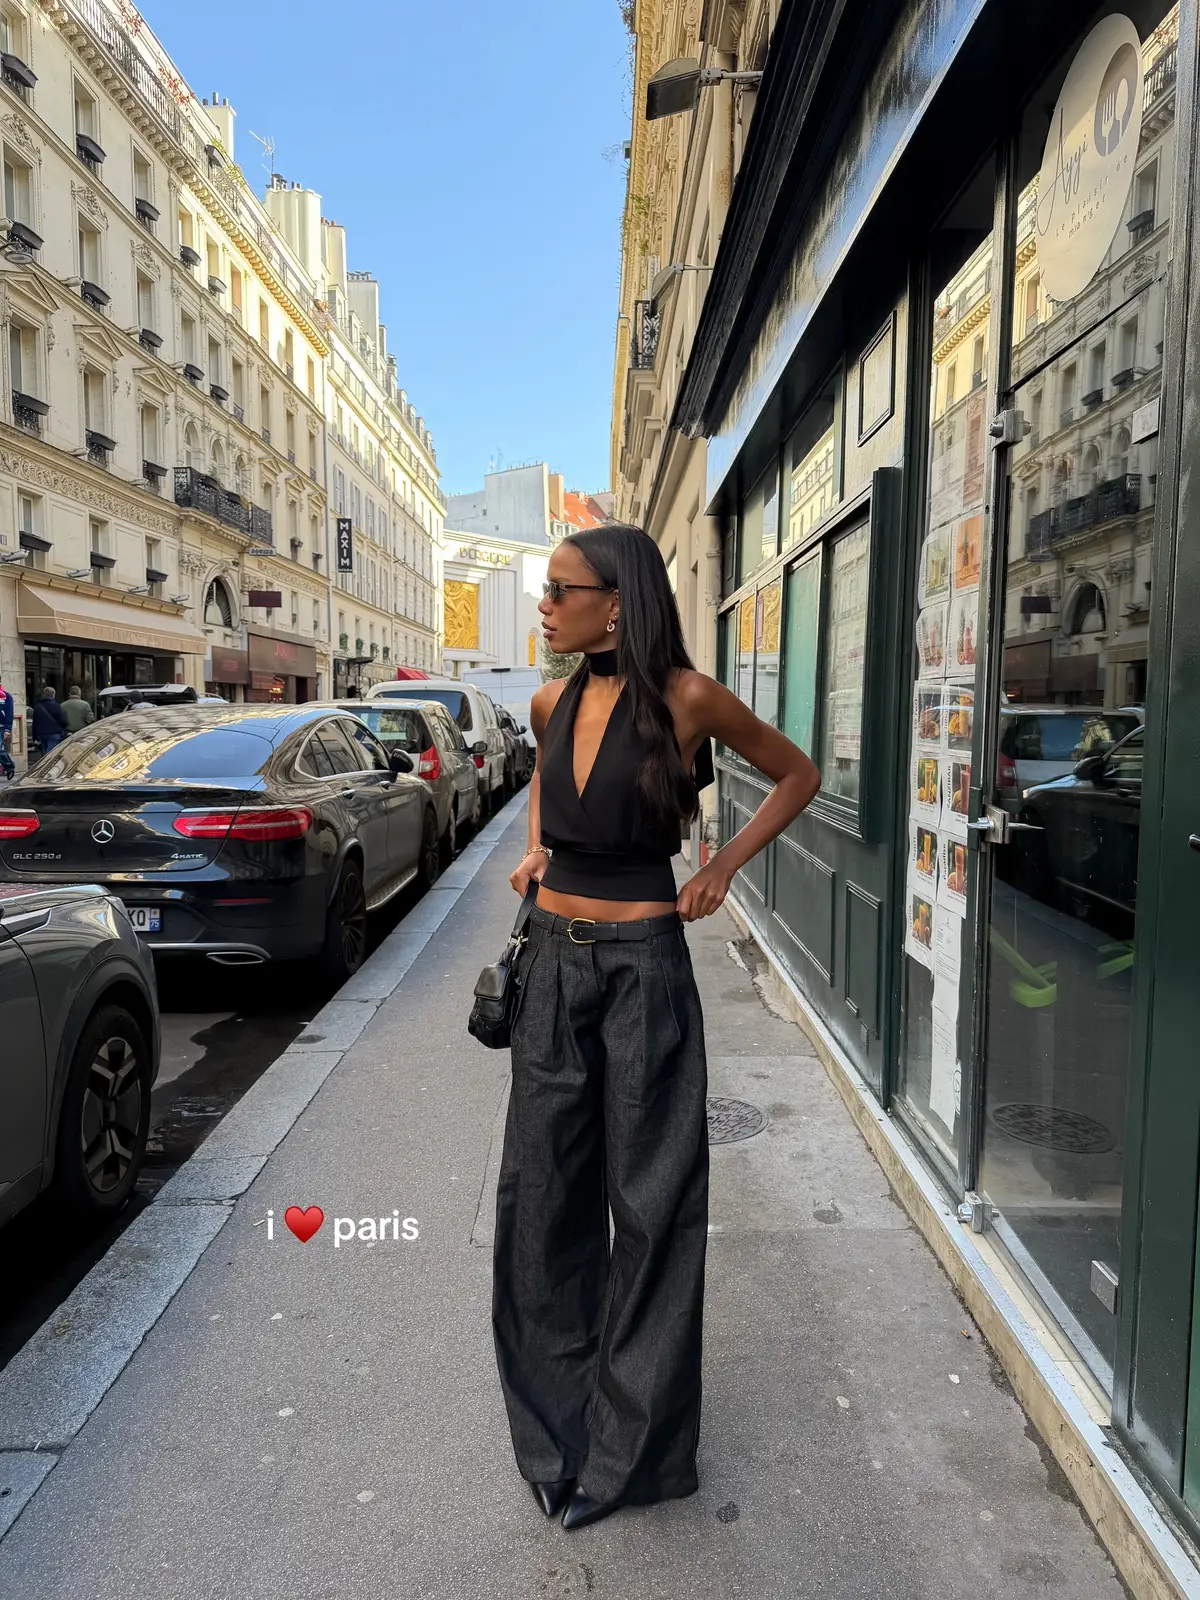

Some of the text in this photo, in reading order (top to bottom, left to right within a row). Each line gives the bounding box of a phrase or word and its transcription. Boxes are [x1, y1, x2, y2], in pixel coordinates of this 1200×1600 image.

[1071, 175, 1109, 224] plaisir
[340, 521, 350, 566] MAXIM
[150, 919, 160, 928] 75
